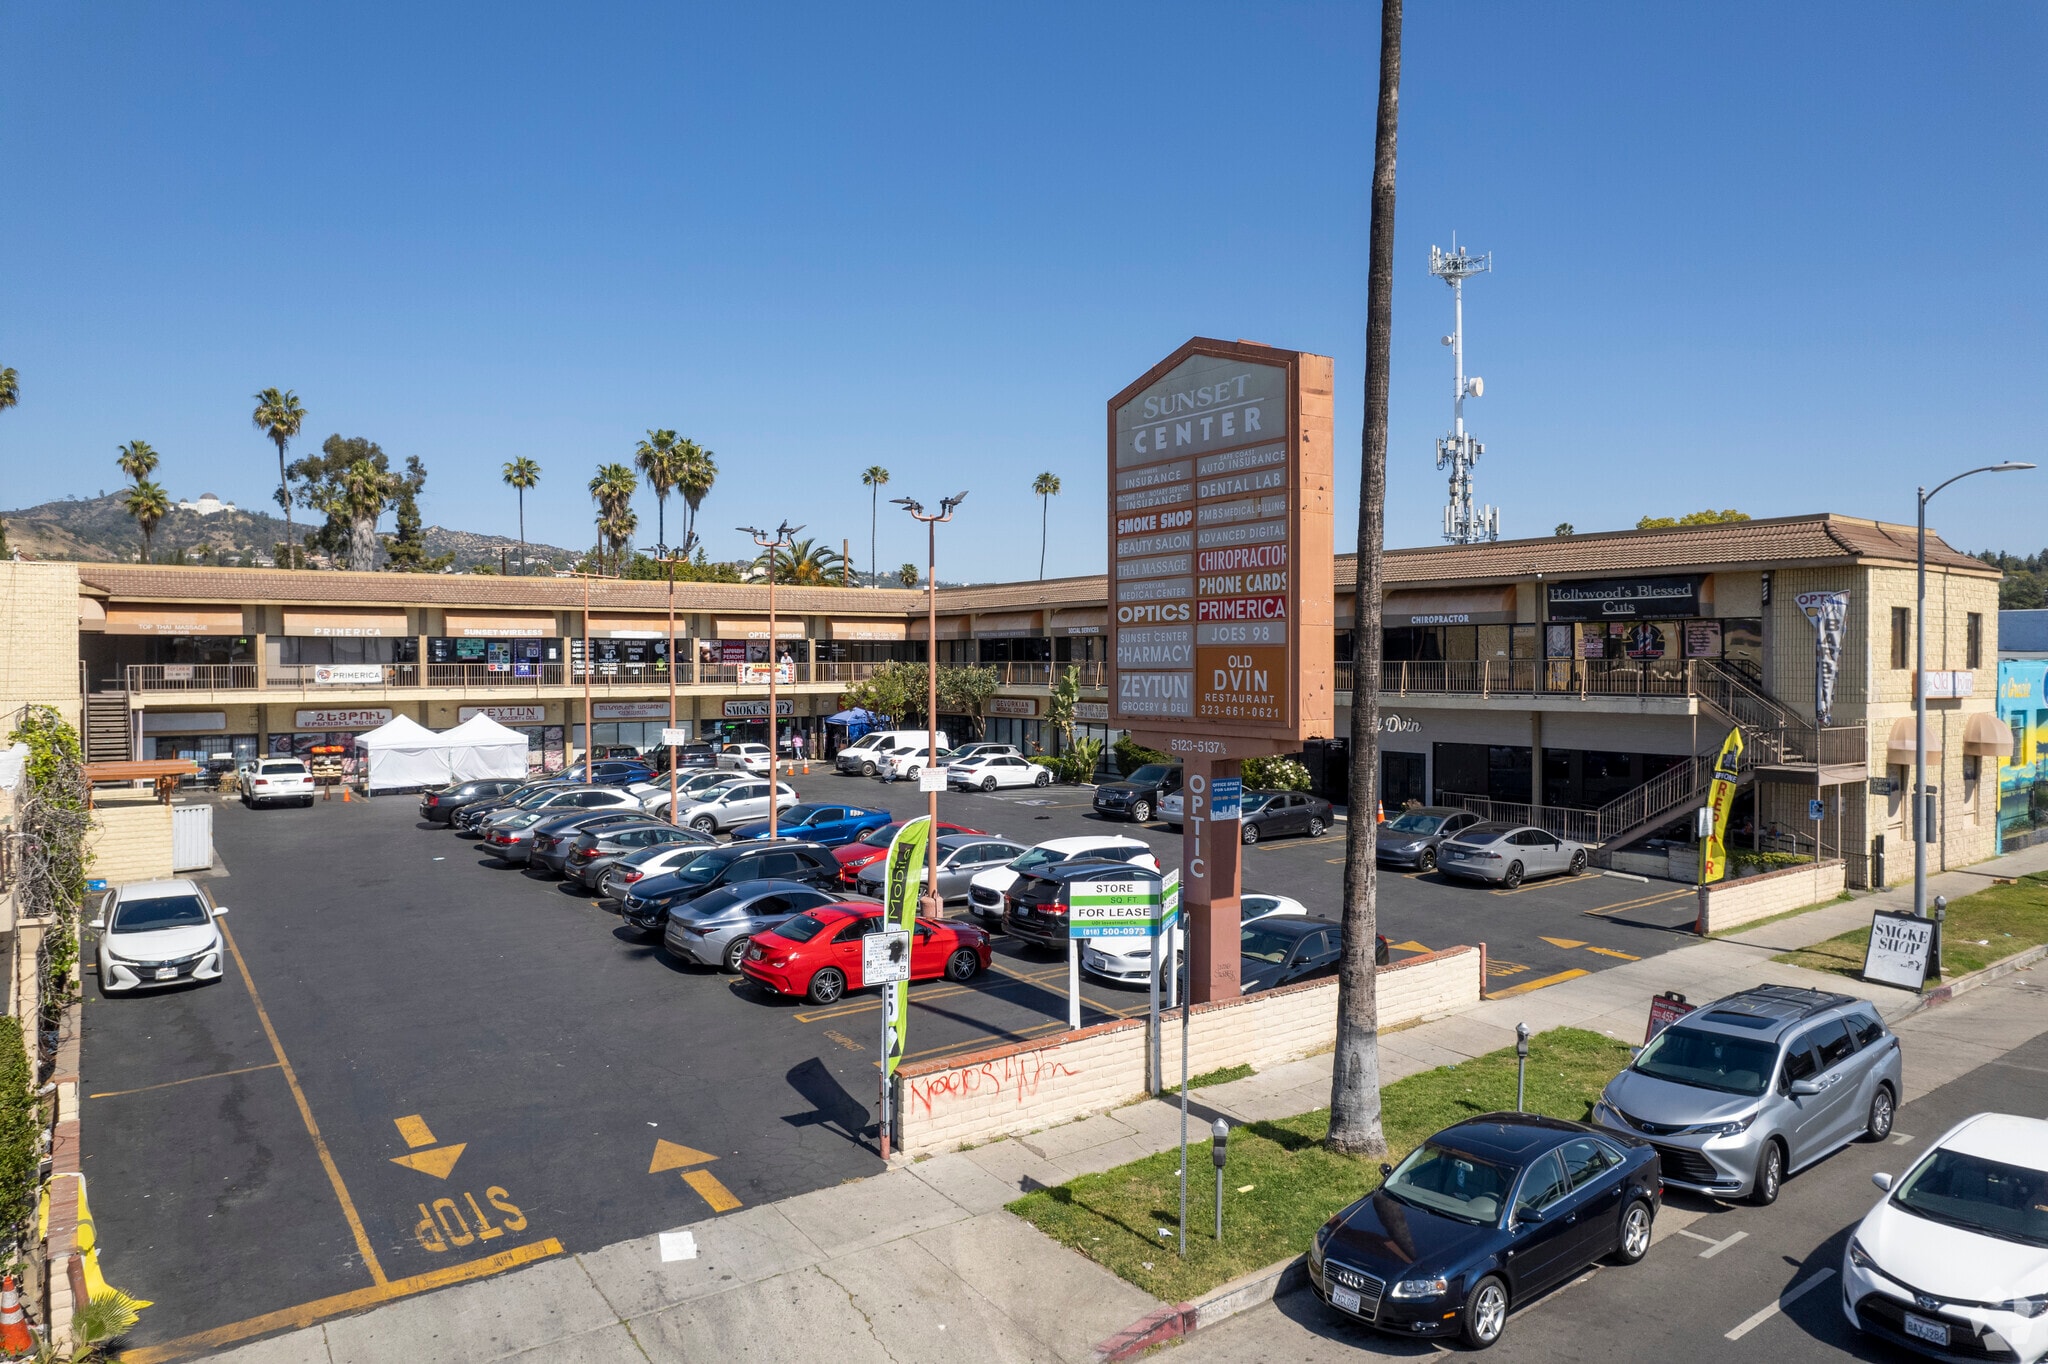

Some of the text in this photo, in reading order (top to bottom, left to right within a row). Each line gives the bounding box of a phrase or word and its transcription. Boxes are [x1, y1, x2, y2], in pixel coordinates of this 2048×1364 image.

[1143, 374, 1251, 419] SUNSET
[1134, 406, 1262, 454] CENTER
[1200, 450, 1286, 474] AUTO INSURANCE
[1126, 470, 1181, 488] INSURANCE
[1201, 472, 1281, 498] DENTAL LAB
[1149, 487, 1168, 497] NOTARY
[1126, 494, 1182, 510] INSURANCE
[1198, 501, 1286, 521] PMBS MEDICAL BILLING
[1118, 510, 1193, 535] SMOKE SHOP
[1199, 525, 1286, 544] ADVANCED DIGITAL
[1118, 534, 1190, 554] BEAUTY SALON
[1199, 545, 1287, 572] CHIROPRACTOR
[1118, 559, 1187, 577] THAI MASSAGE
[1200, 572, 1287, 595] PHONE CARDS
[1637, 583, 1692, 597] Blessed
[1120, 587, 1186, 600] MEDICAL CENTER
[1118, 603, 1190, 623] OPTICS
[1199, 598, 1286, 620] PRIMERICA
[1602, 601, 1635, 613] Cuts
[1411, 614, 1470, 624] CHIROPRACTOR
[314, 628, 382, 636] PRIMERICA
[1081, 626, 1099, 634] SERVICES
[1120, 631, 1188, 643] SUNSET CENTER
[1211, 626, 1270, 641] JOES 98
[528, 648, 538, 656] 10
[1118, 644, 1192, 663] PHARMACY
[1228, 655, 1252, 669] OLD
[333, 671, 380, 680] PRIMERICA
[1214, 670, 1268, 692] DVIN
[1933, 672, 1973, 690] Old Dvin
[1121, 674, 1188, 699] ZEYTUN
[996, 700, 1029, 708] GEVORKIAN
[1122, 701, 1159, 712] GROCERY
[1162, 702, 1168, 712] &
[1170, 702, 1188, 713] DELI
[1205, 693, 1275, 704] RESTAURANT
[726, 704, 758, 716] SMOKE
[1201, 704, 1279, 718] 323-661-0621
[1385, 714, 1422, 733] Dvin
[1189, 774, 1206, 878] OPTIC
[888, 847, 911, 919] Mobile
[1096, 884, 1134, 893] STORE
[1078, 908, 1151, 917] FOR LEASE
[1082, 928, 1146, 936] (818) 500-0973
[1874, 923, 1928, 944] SMOKE
[1878, 937, 1921, 954] SHOP
[1662, 1010, 1674, 1022] 455
[414, 1185, 528, 1252] STOP
